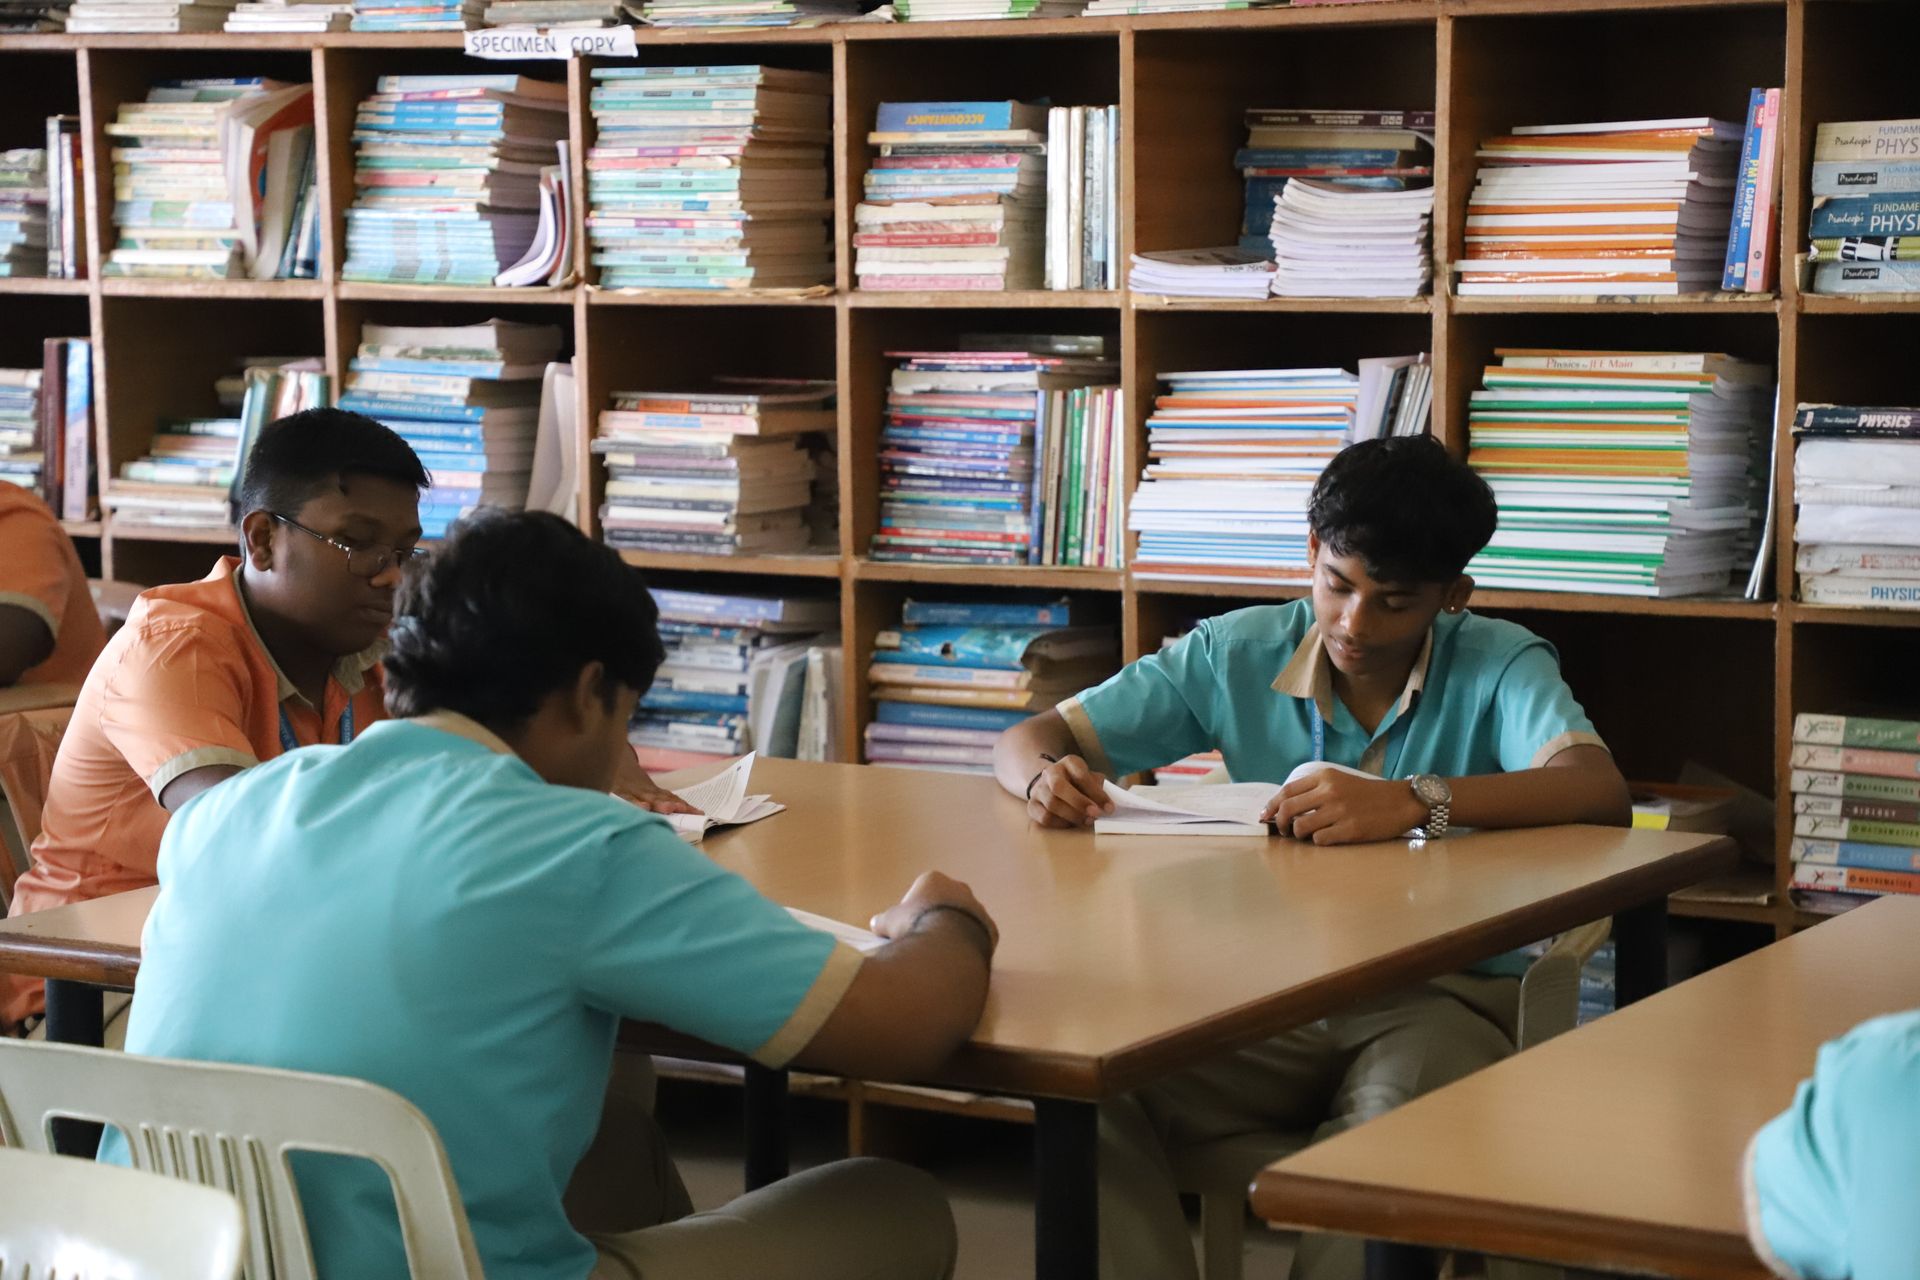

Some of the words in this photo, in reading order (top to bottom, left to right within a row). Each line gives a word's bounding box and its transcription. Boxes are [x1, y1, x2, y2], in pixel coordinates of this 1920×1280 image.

[471, 36, 557, 53] SPECIMEN
[570, 36, 616, 52] COPY
[1746, 159, 1760, 185] PMT
[1741, 187, 1755, 229] CAPSULE
[1545, 356, 1580, 369] Physics
[1608, 358, 1633, 369] Main
[1857, 413, 1913, 429] PHYSICS
